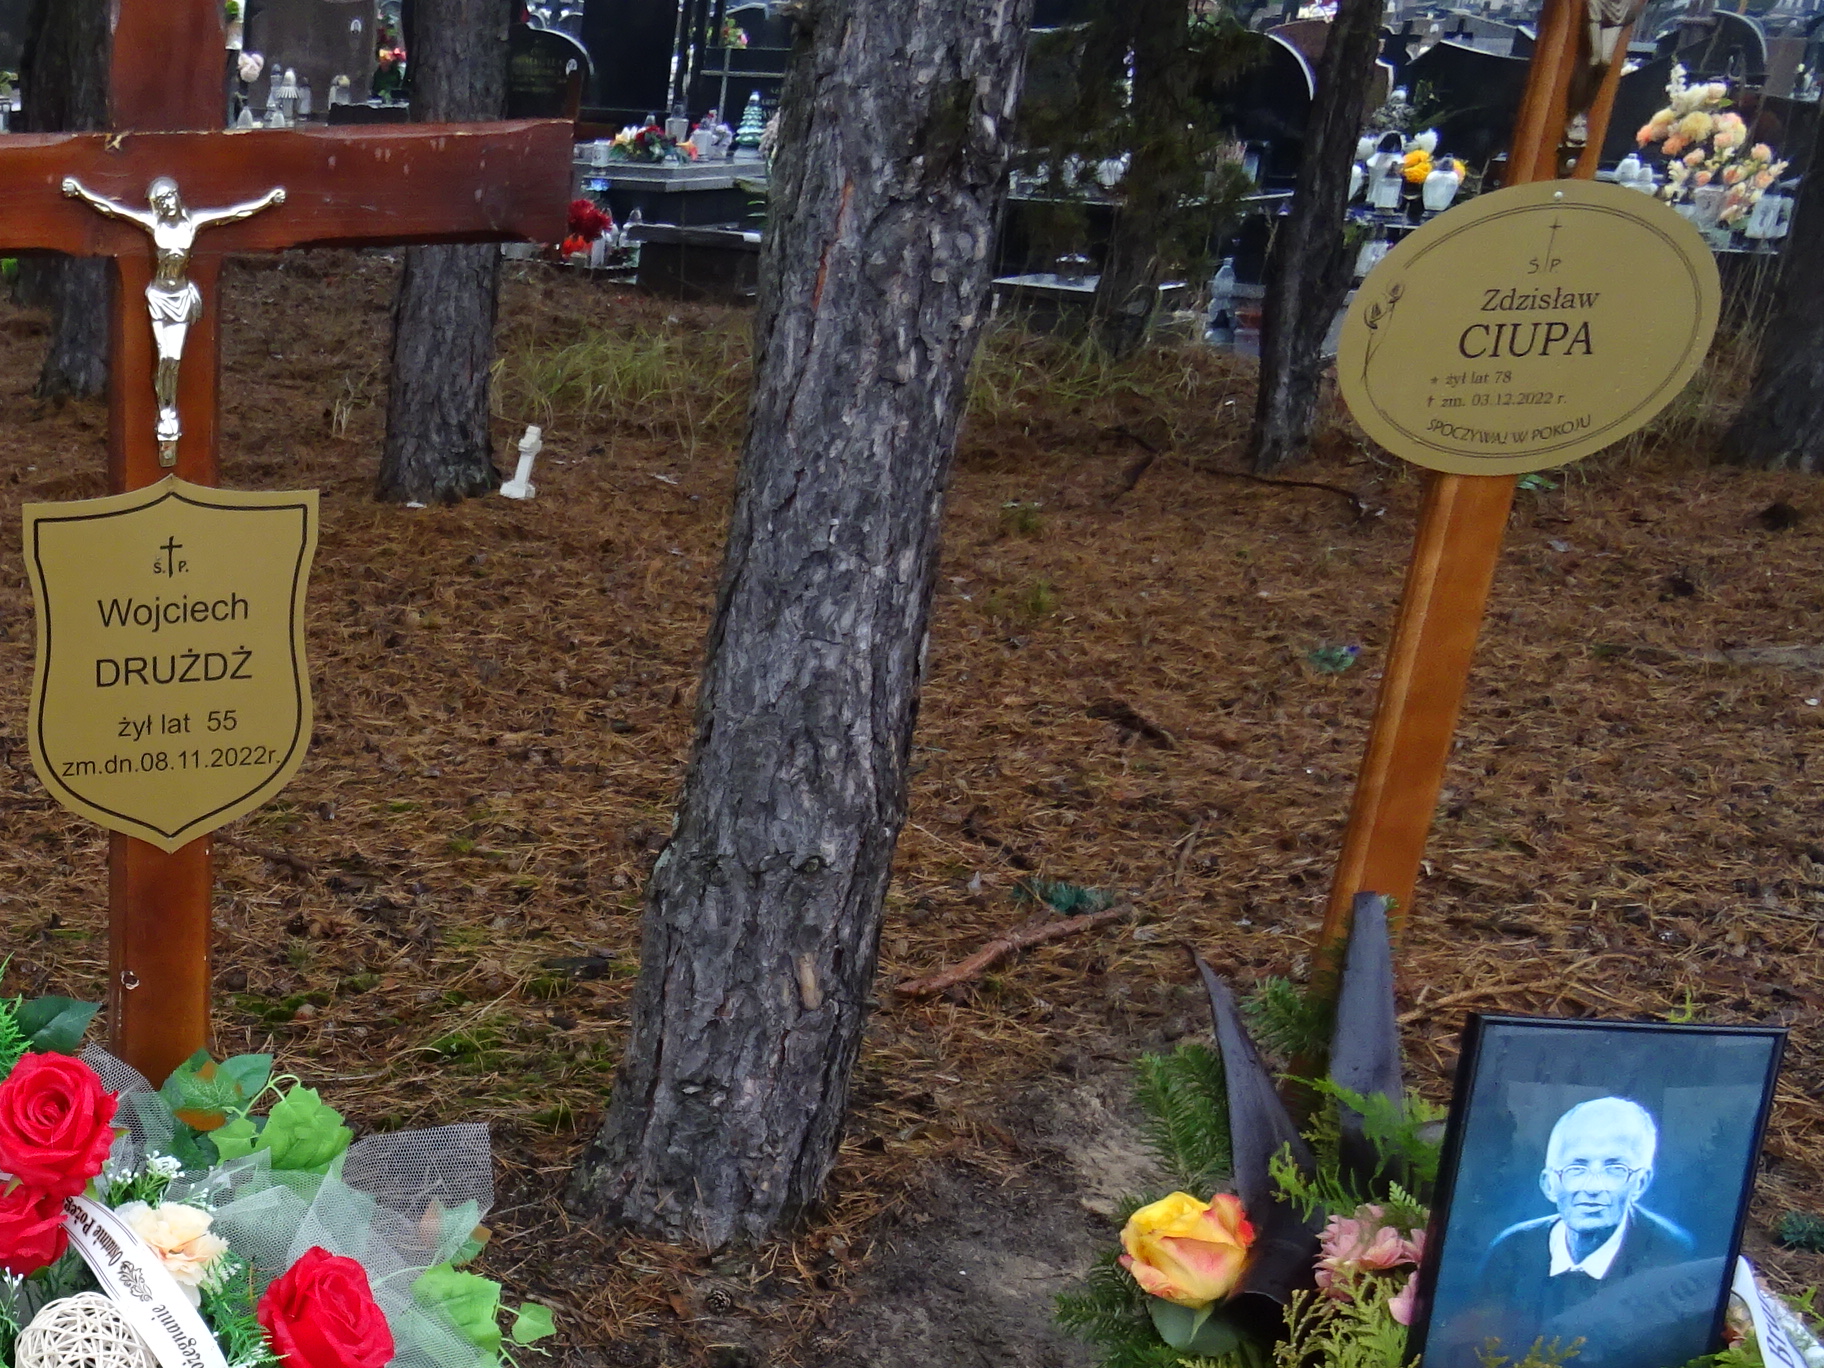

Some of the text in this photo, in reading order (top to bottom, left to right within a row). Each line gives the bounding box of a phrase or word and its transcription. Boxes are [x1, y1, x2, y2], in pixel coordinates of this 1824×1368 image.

[1480, 286, 1601, 312] Zdzisław
[1459, 321, 1594, 360] CIUPA
[1445, 371, 1513, 389] żył lat 78
[1441, 397, 1466, 408] zm.
[1471, 392, 1554, 406] 03.12.2022
[1426, 414, 1591, 445] SPOCZYWAJ W POKOJU
[97, 592, 249, 632] Wojciech
[95, 645, 253, 688] DRUŻDŻ
[117, 710, 238, 742] żył lat 55
[62, 745, 281, 777] zm.dn.08.11.2022r.
[63, 1196, 124, 1267] Ostatnie Pożeg
